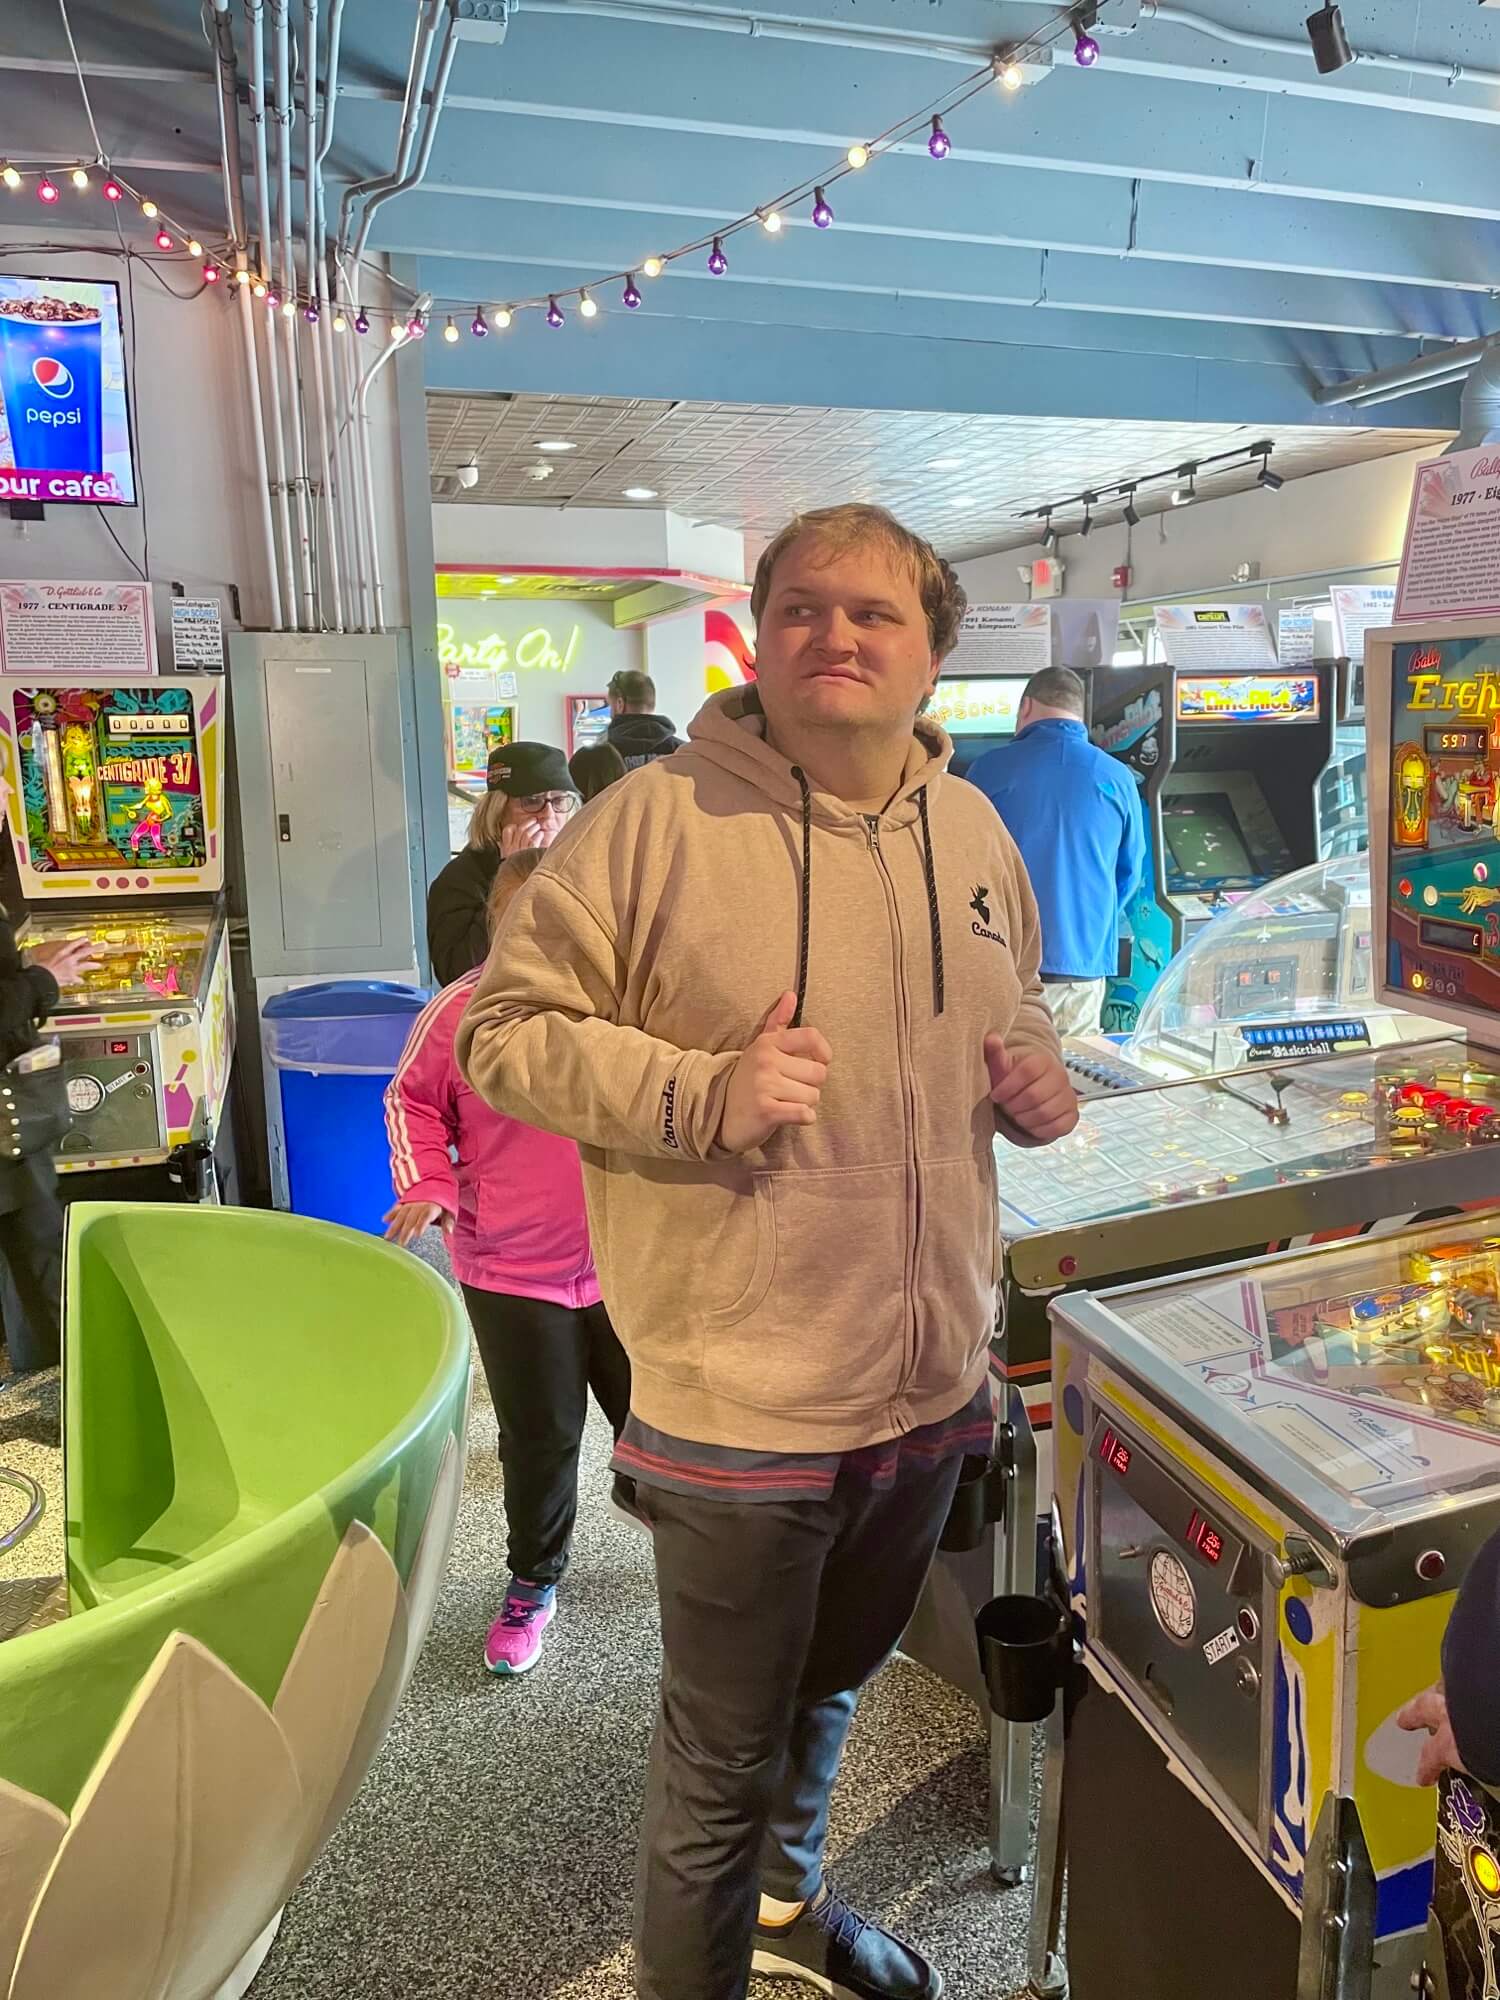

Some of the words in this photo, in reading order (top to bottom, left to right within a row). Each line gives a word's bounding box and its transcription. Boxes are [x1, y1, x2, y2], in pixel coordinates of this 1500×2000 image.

[26, 407, 81, 428] pepsi
[48, 474, 117, 498] cafe!
[1451, 490, 1476, 506] 1977
[18, 602, 39, 610] 1977
[48, 602, 114, 611] CENTIGRADE
[118, 602, 128, 612] 37
[437, 623, 507, 672] Party
[515, 624, 579, 673] On!
[1408, 648, 1440, 672] Bally
[1203, 689, 1247, 711] Time
[1249, 688, 1291, 711] Pilot
[97, 756, 169, 784] CENTIGRADE
[170, 752, 192, 785] 37
[971, 921, 1007, 948] Canada
[1272, 1042, 1330, 1058] Basketball
[662, 1076, 679, 1148] Canada
[1206, 1531, 1220, 1549] 25¢
[1204, 1632, 1232, 1663] START
